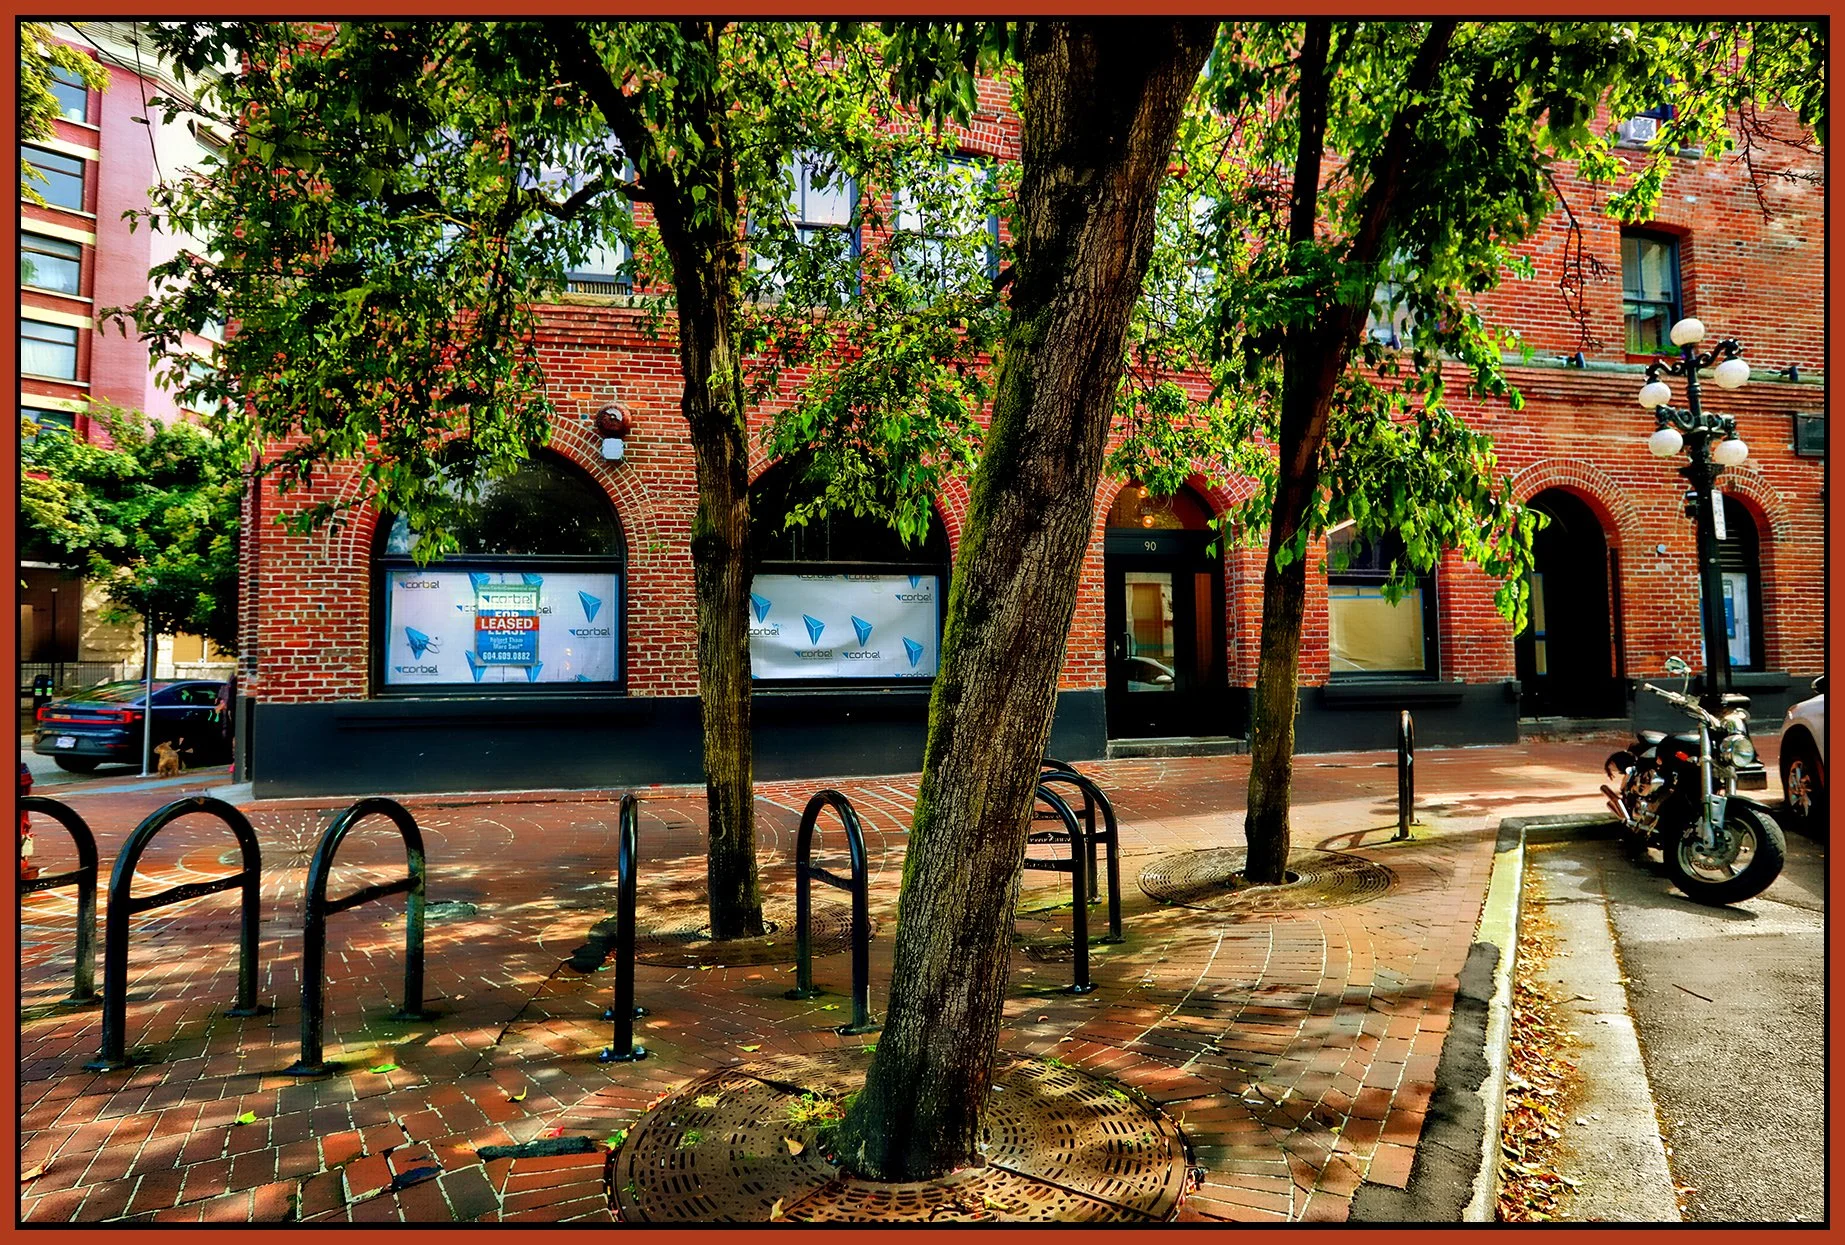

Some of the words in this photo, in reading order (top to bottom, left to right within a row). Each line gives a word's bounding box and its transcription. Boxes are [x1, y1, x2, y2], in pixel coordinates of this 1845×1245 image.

[1144, 541, 1157, 551] 90
[405, 580, 440, 589] corbel
[491, 594, 533, 604] corbel
[901, 593, 932, 601] corbel
[481, 618, 534, 630] LEASED
[576, 627, 611, 636] corbel
[801, 649, 833, 657] corbel
[849, 651, 880, 659] corbel
[402, 665, 438, 674] corbel
